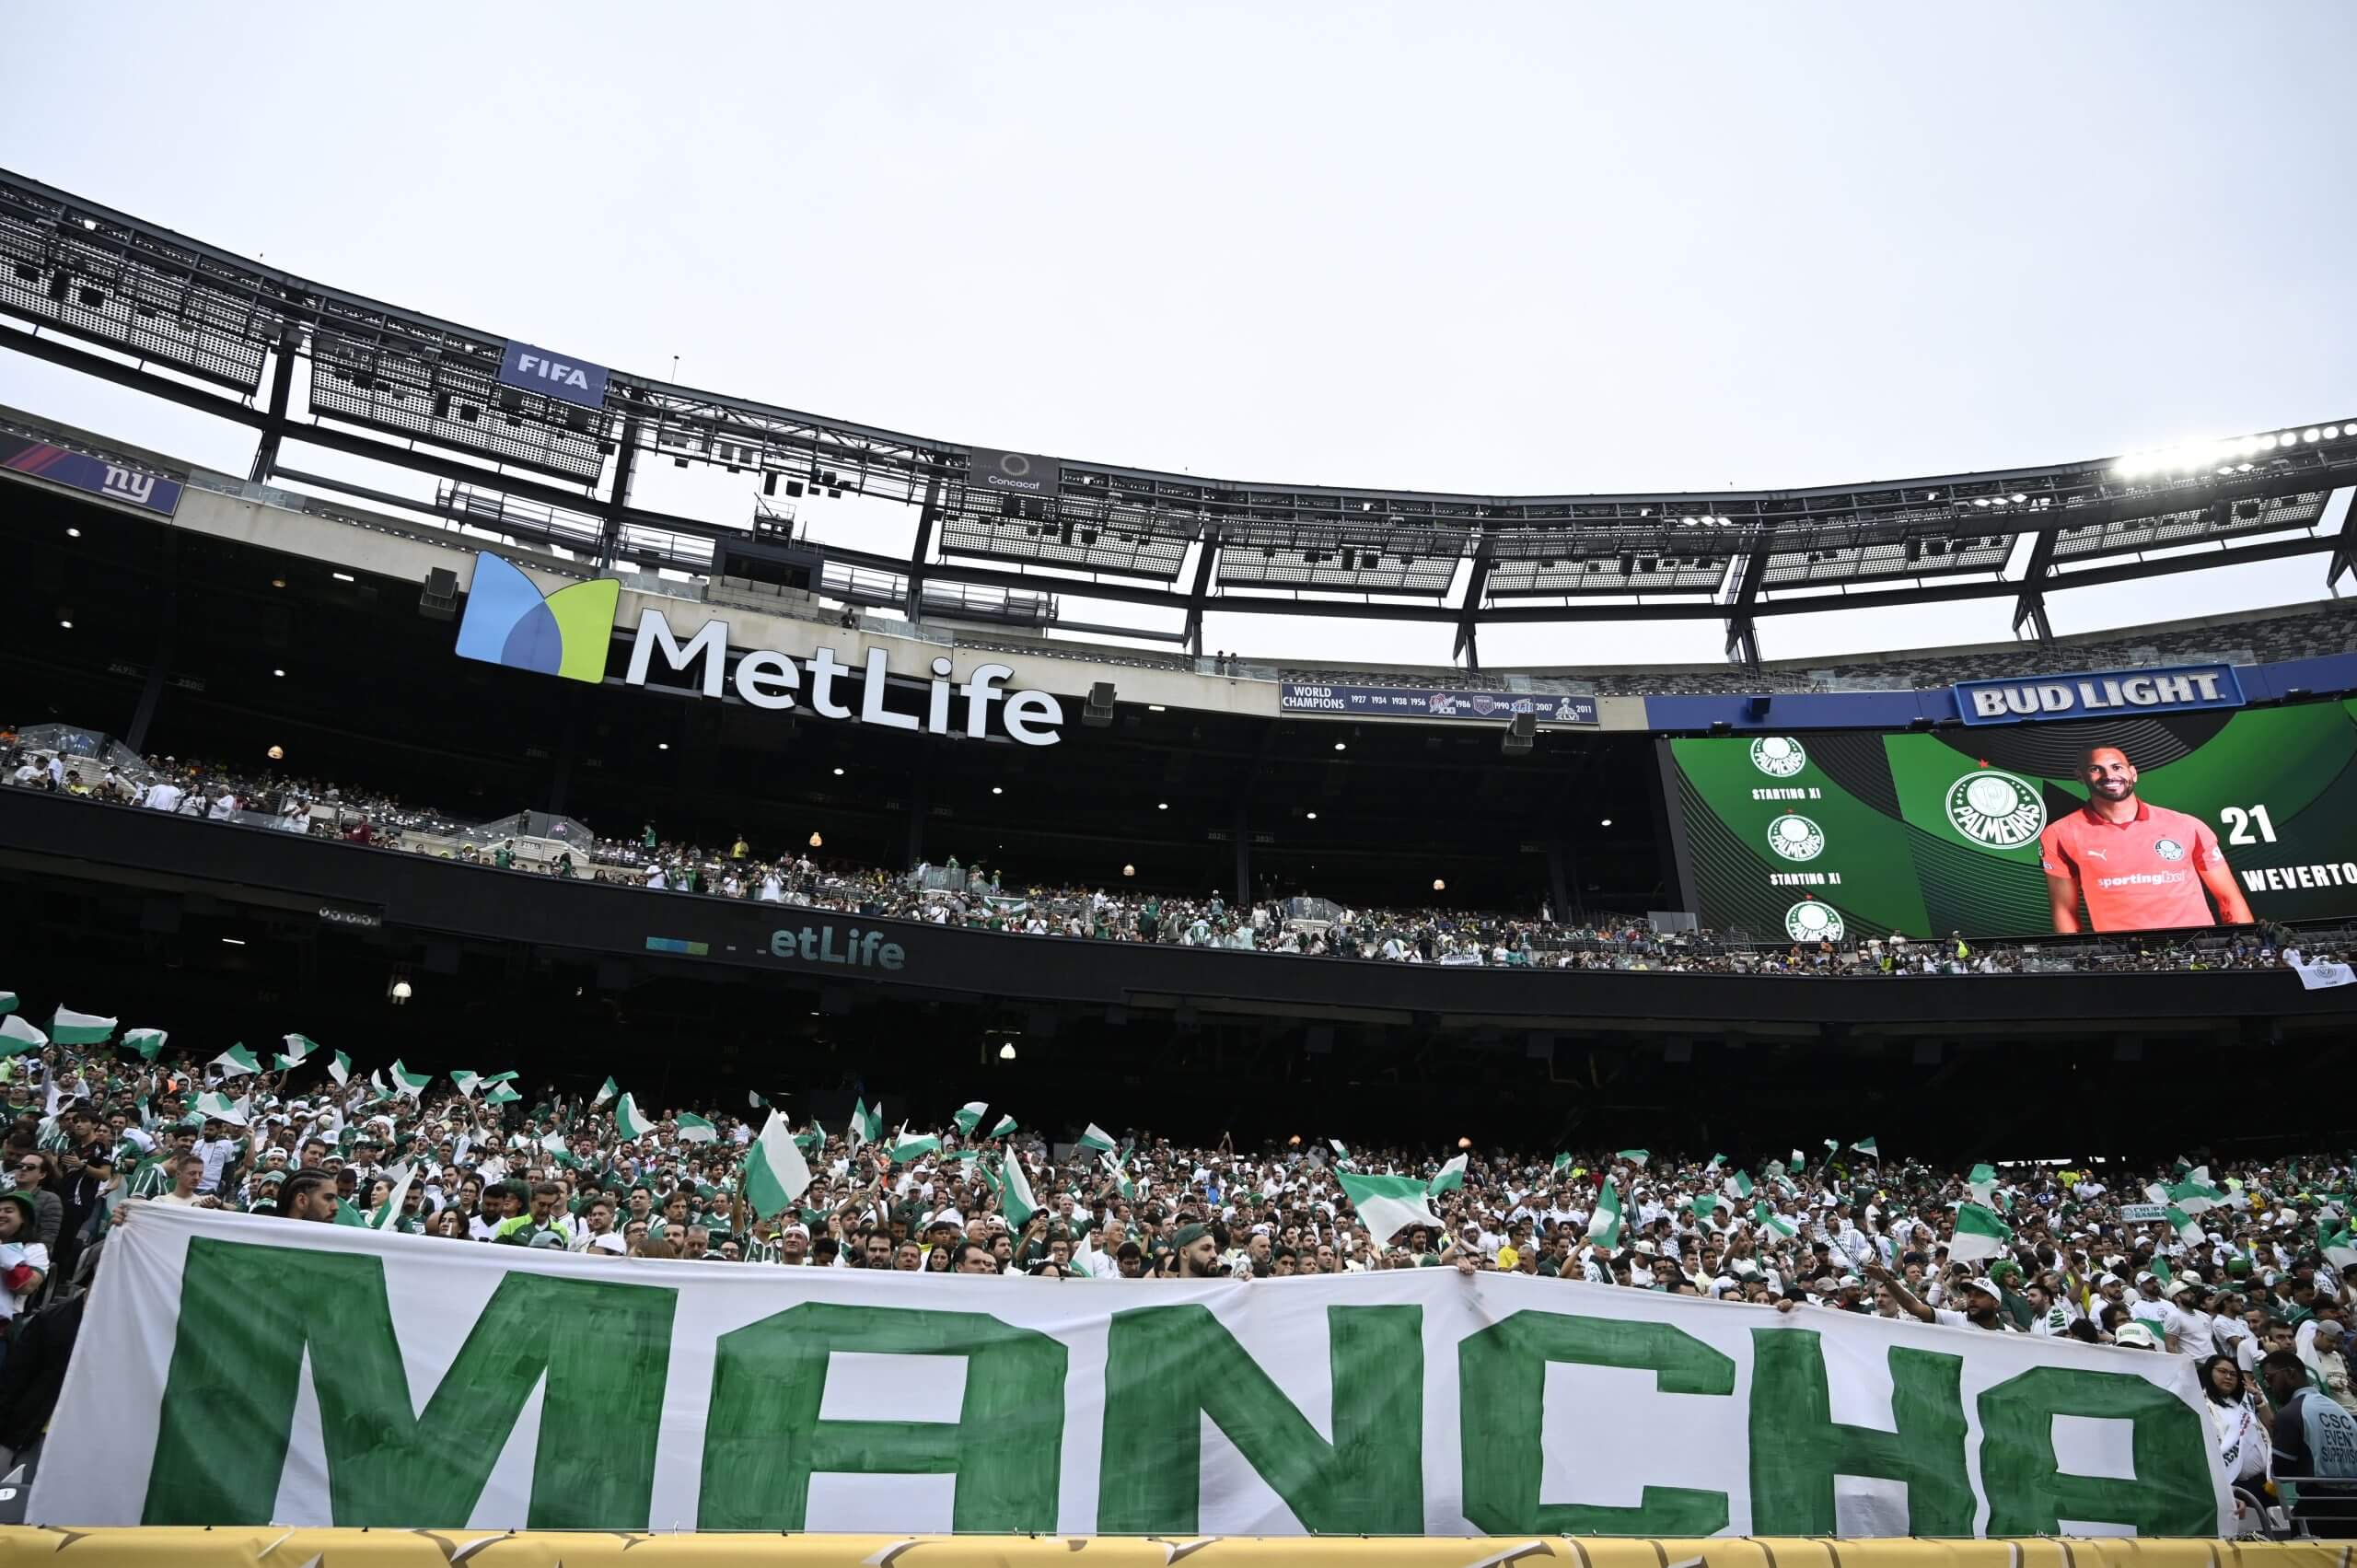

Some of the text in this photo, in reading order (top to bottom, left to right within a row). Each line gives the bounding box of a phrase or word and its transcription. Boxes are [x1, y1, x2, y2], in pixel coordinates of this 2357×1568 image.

[517, 353, 588, 390] FIFA
[101, 465, 155, 504] ny
[988, 475, 1039, 491] Concacaf
[625, 608, 1064, 746] MetLife
[1293, 686, 1331, 698] WORLD
[1283, 696, 1344, 709] CHAMPIONS
[1351, 695, 1366, 703] 1927
[1371, 696, 1387, 705] 1934
[1391, 697, 1408, 706] 1938
[1411, 697, 1426, 706] 1956
[1456, 700, 1471, 708] 1986
[1493, 702, 1510, 710] 1990
[1536, 703, 1553, 711] 2007
[1575, 705, 1592, 714] 2011
[1972, 672, 2220, 717] BUD LIGHT
[1752, 787, 1821, 800] STARTING XI
[1953, 803, 2040, 844] PALMEIRAS
[2220, 804, 2277, 845] 21
[1770, 872, 1841, 885] STARTING XI
[2242, 862, 2357, 892] WEVERTO
[726, 926, 905, 970] etLife
[141, 1237, 2219, 1537] MANCHA
[2319, 1412, 2351, 1430] CSC
